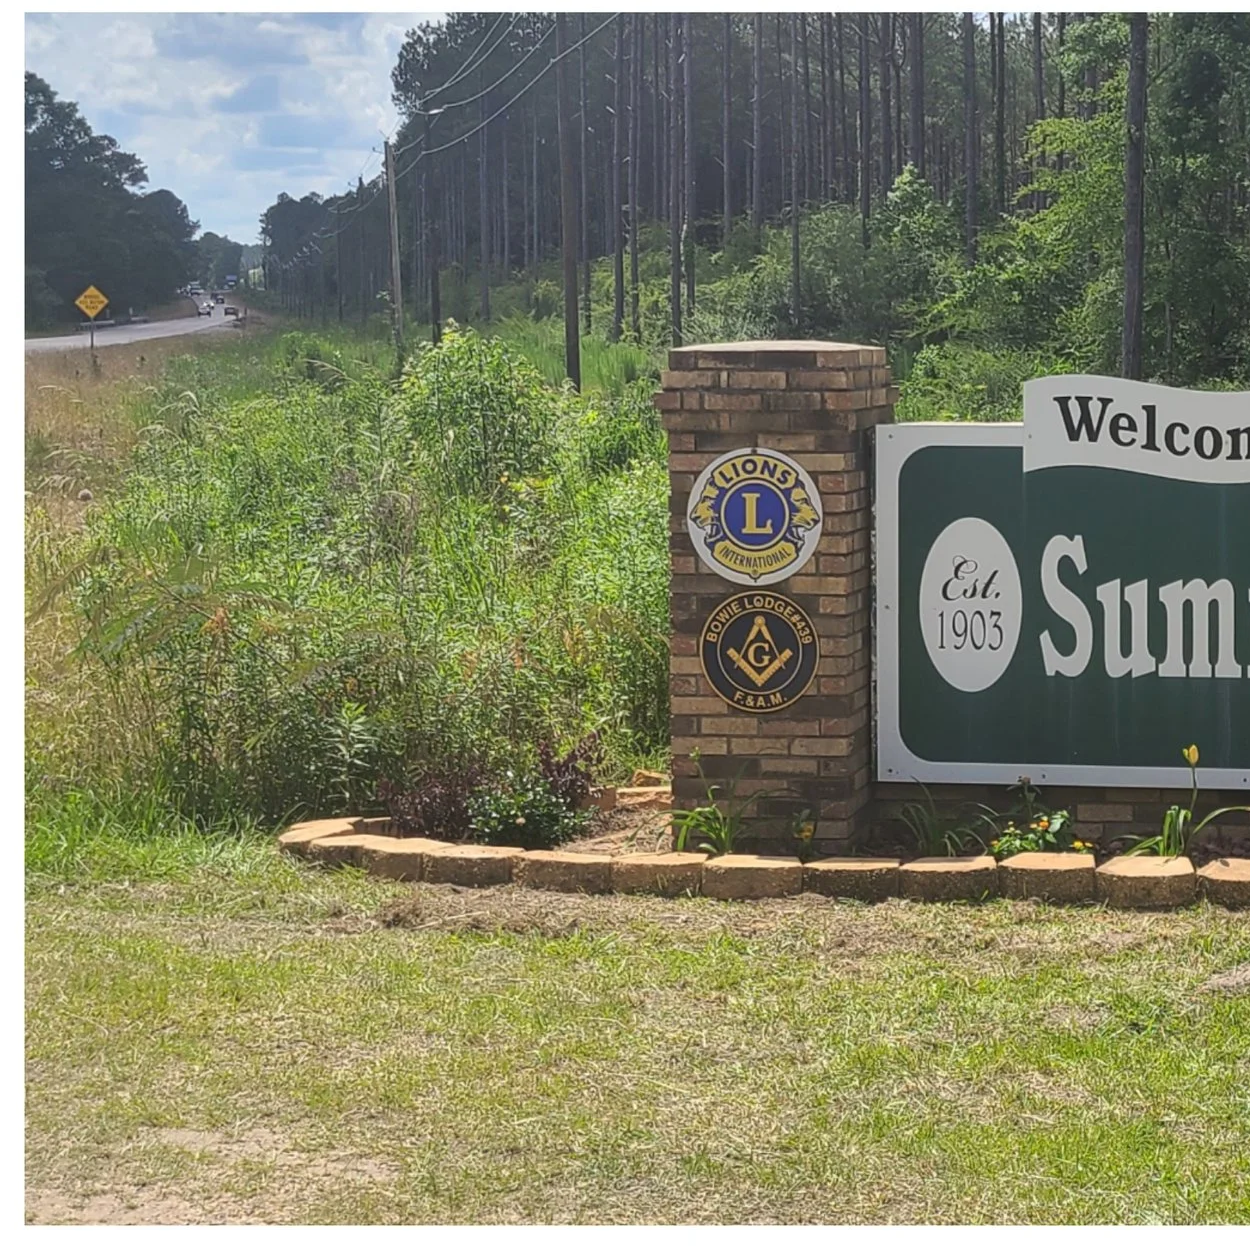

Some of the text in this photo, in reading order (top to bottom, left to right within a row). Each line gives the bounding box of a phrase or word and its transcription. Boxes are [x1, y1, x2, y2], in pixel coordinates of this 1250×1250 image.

[718, 458, 792, 485] LIONS
[741, 493, 773, 534] L
[719, 546, 792, 568] INTERNATIONAL
[941, 555, 1001, 601] Est.
[705, 596, 813, 644] BOWIE LODGE#439
[937, 609, 1004, 651] 1903
[747, 642, 771, 667] G
[734, 691, 787, 708] F.&A.M.
